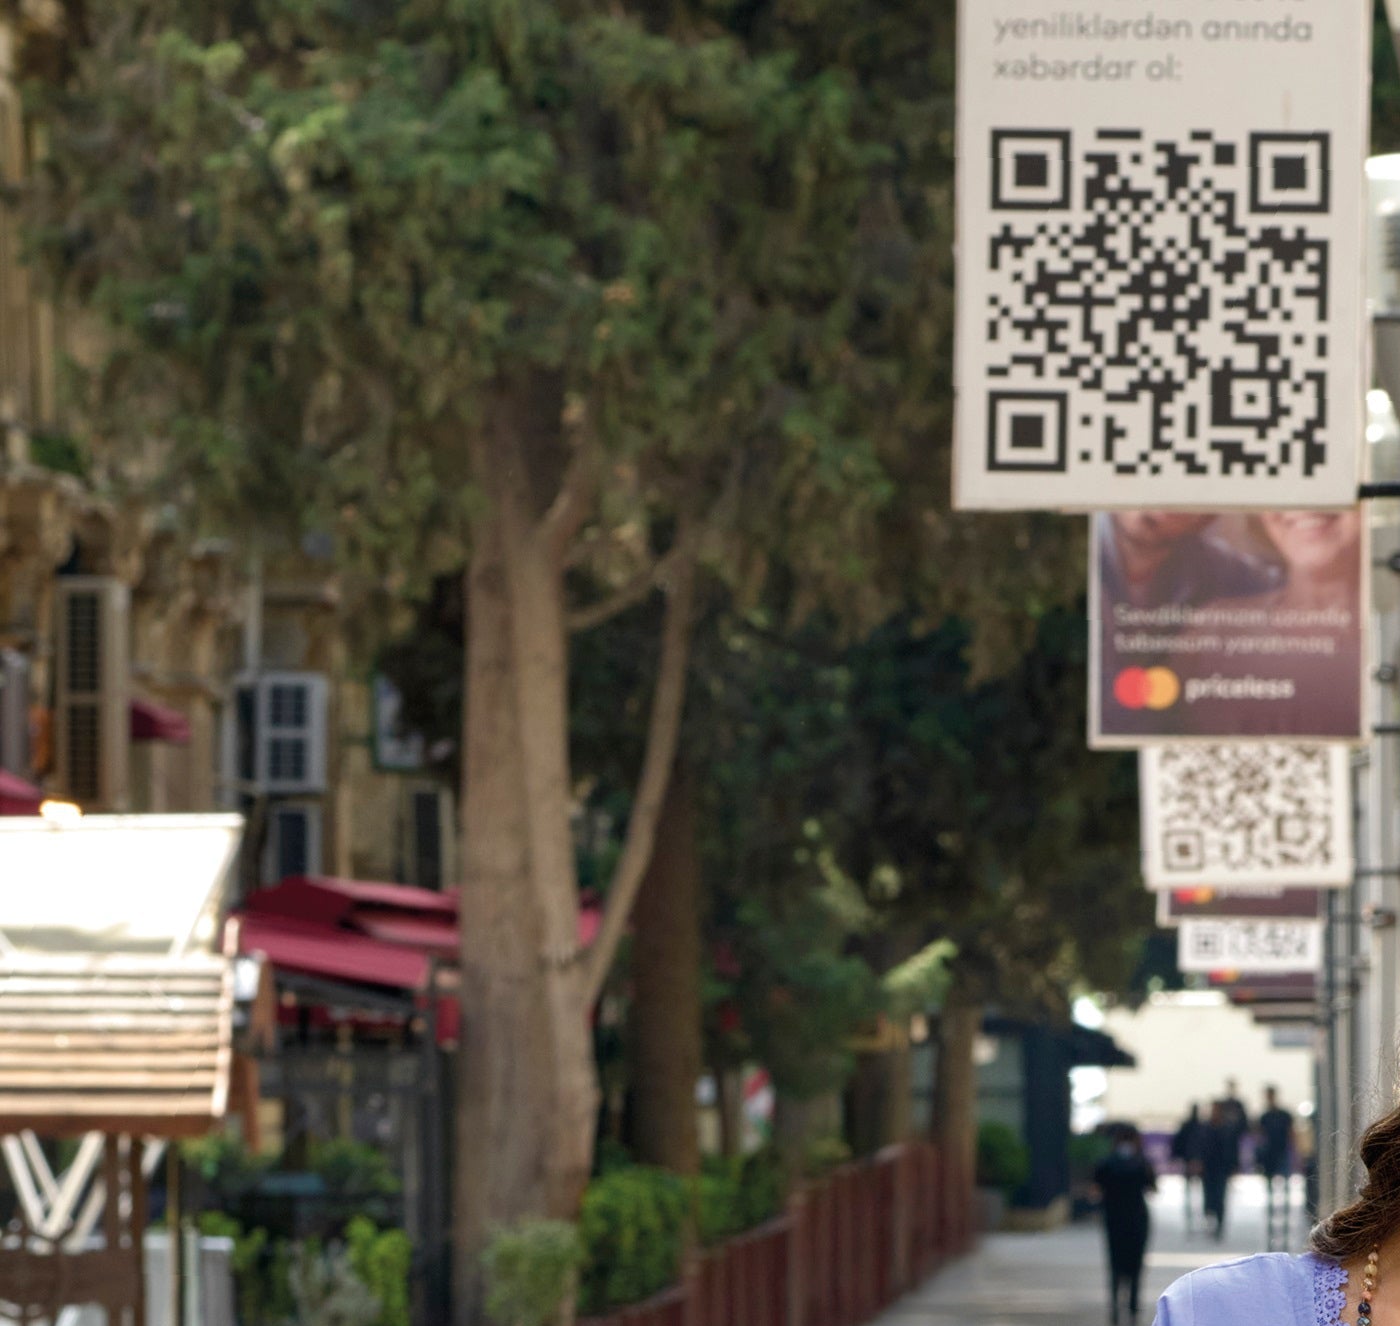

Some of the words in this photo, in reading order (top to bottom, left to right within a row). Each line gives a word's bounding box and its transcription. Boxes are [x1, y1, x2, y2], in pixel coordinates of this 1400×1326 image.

[1201, 14, 1314, 43] anında
[993, 52, 1137, 82] xəbərdar
[1185, 674, 1295, 703] priceless
